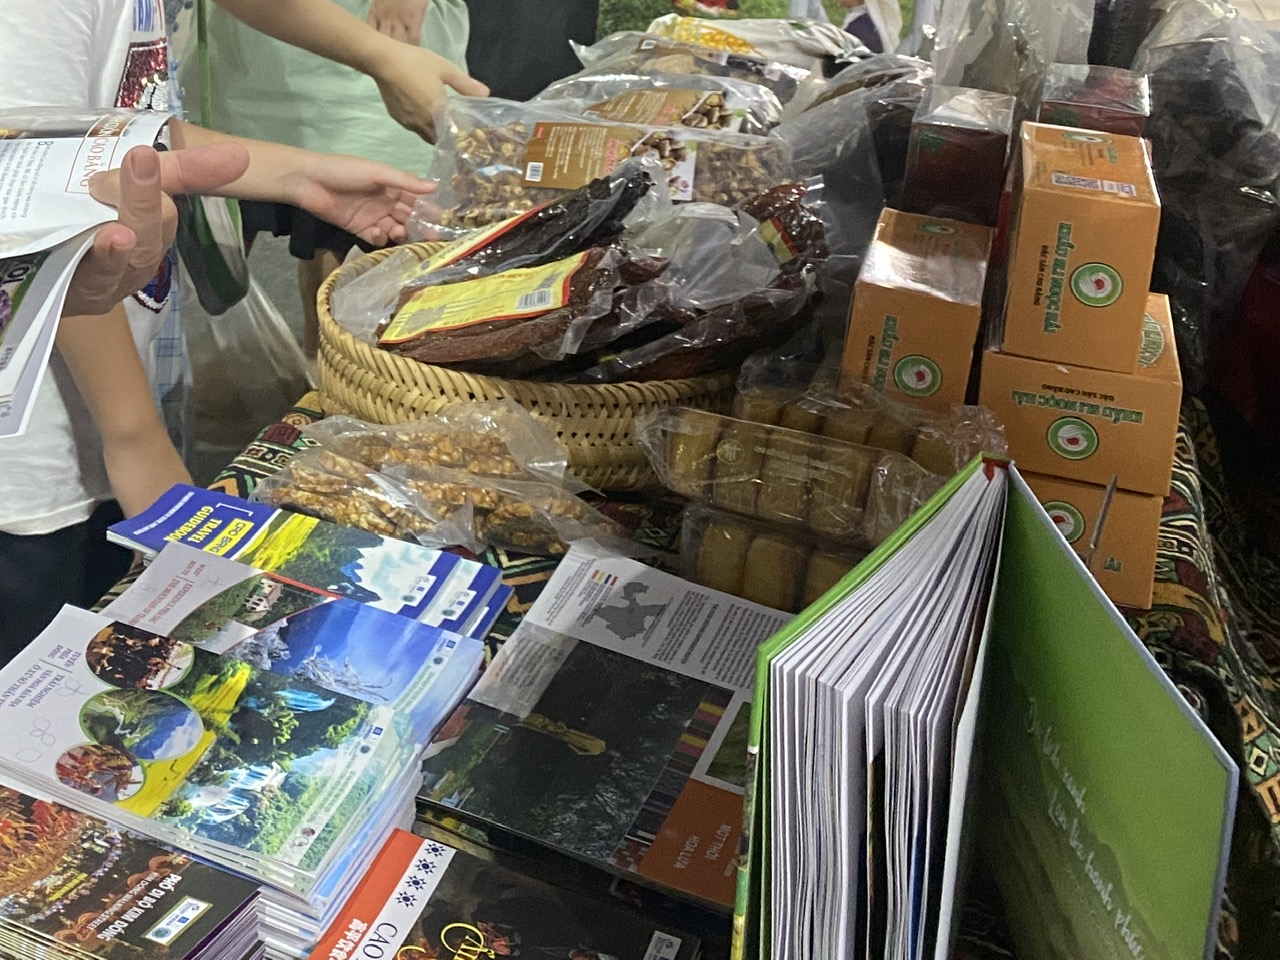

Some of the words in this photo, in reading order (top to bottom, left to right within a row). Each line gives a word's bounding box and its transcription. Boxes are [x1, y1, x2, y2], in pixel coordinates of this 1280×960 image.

[89, 137, 108, 153] CAO
[186, 518, 222, 543] TRAVEL
[142, 870, 158, 882] KIM
[157, 873, 182, 891] PHỐ
[147, 888, 166, 898] ĐI
[103, 893, 134, 916] WALKING
[135, 896, 155, 910] BỘ
[85, 912, 110, 930] STREET
[119, 907, 145, 922] KIM
[95, 919, 128, 943] ĐỒNG
[362, 921, 399, 960] CAO
